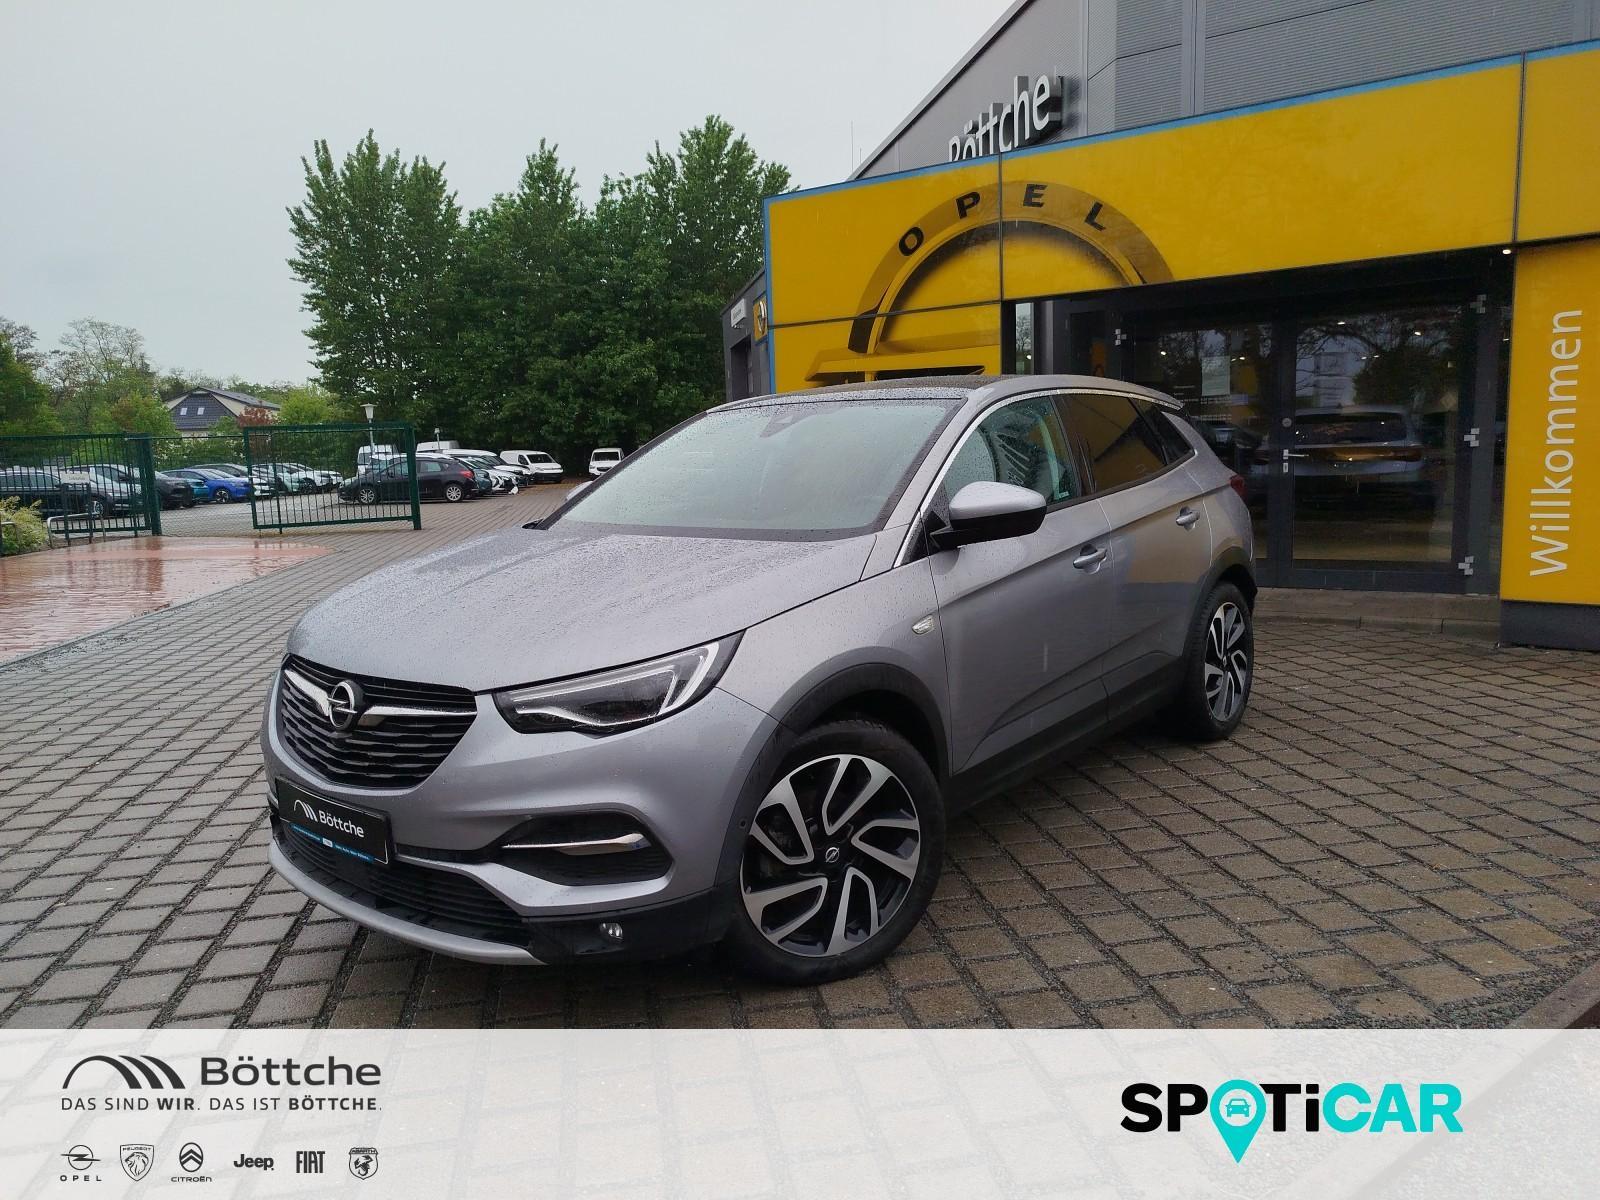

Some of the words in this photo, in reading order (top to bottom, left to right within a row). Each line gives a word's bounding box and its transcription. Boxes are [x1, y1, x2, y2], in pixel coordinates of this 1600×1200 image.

[898, 183, 1107, 257] OPEL
[1529, 309, 1583, 577] Willkommen
[319, 810, 364, 838] Böttche
